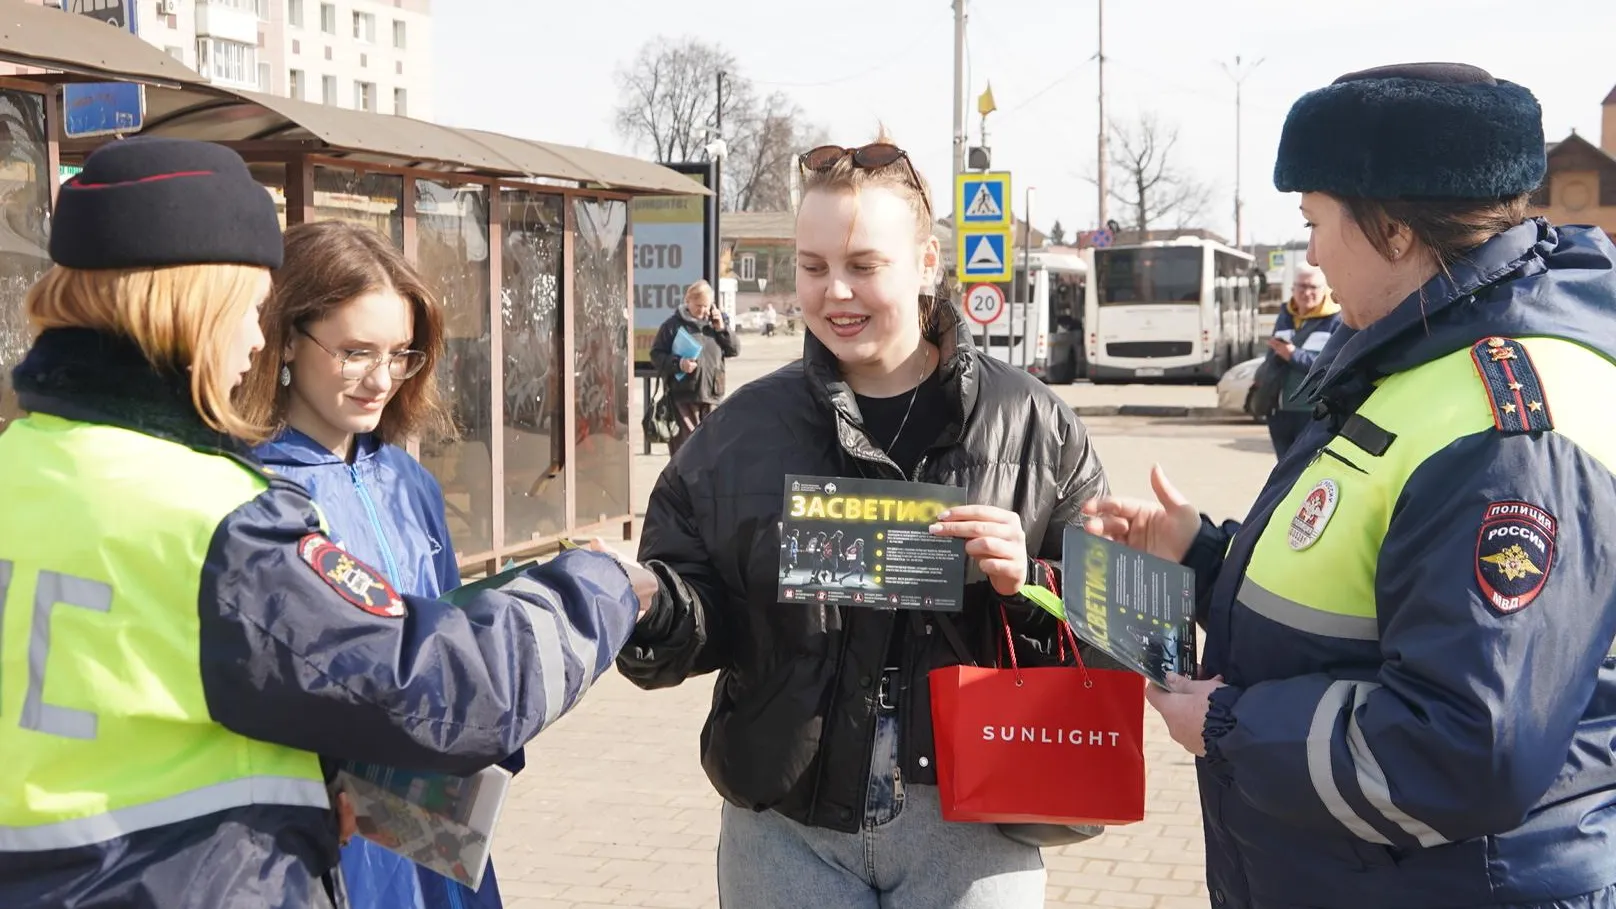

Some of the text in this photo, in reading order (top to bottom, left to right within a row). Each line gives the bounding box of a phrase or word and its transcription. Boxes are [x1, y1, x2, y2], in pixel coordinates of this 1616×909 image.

[975, 295, 995, 311] 20
[790, 495, 945, 522] ЗАСВЕТИС
[1491, 505, 1551, 530] ПОЛИЦИЯ
[1488, 526, 1545, 553] РОССИЯ
[1492, 591, 1519, 610] МВД
[983, 726, 1119, 747] SUNLIGHT
